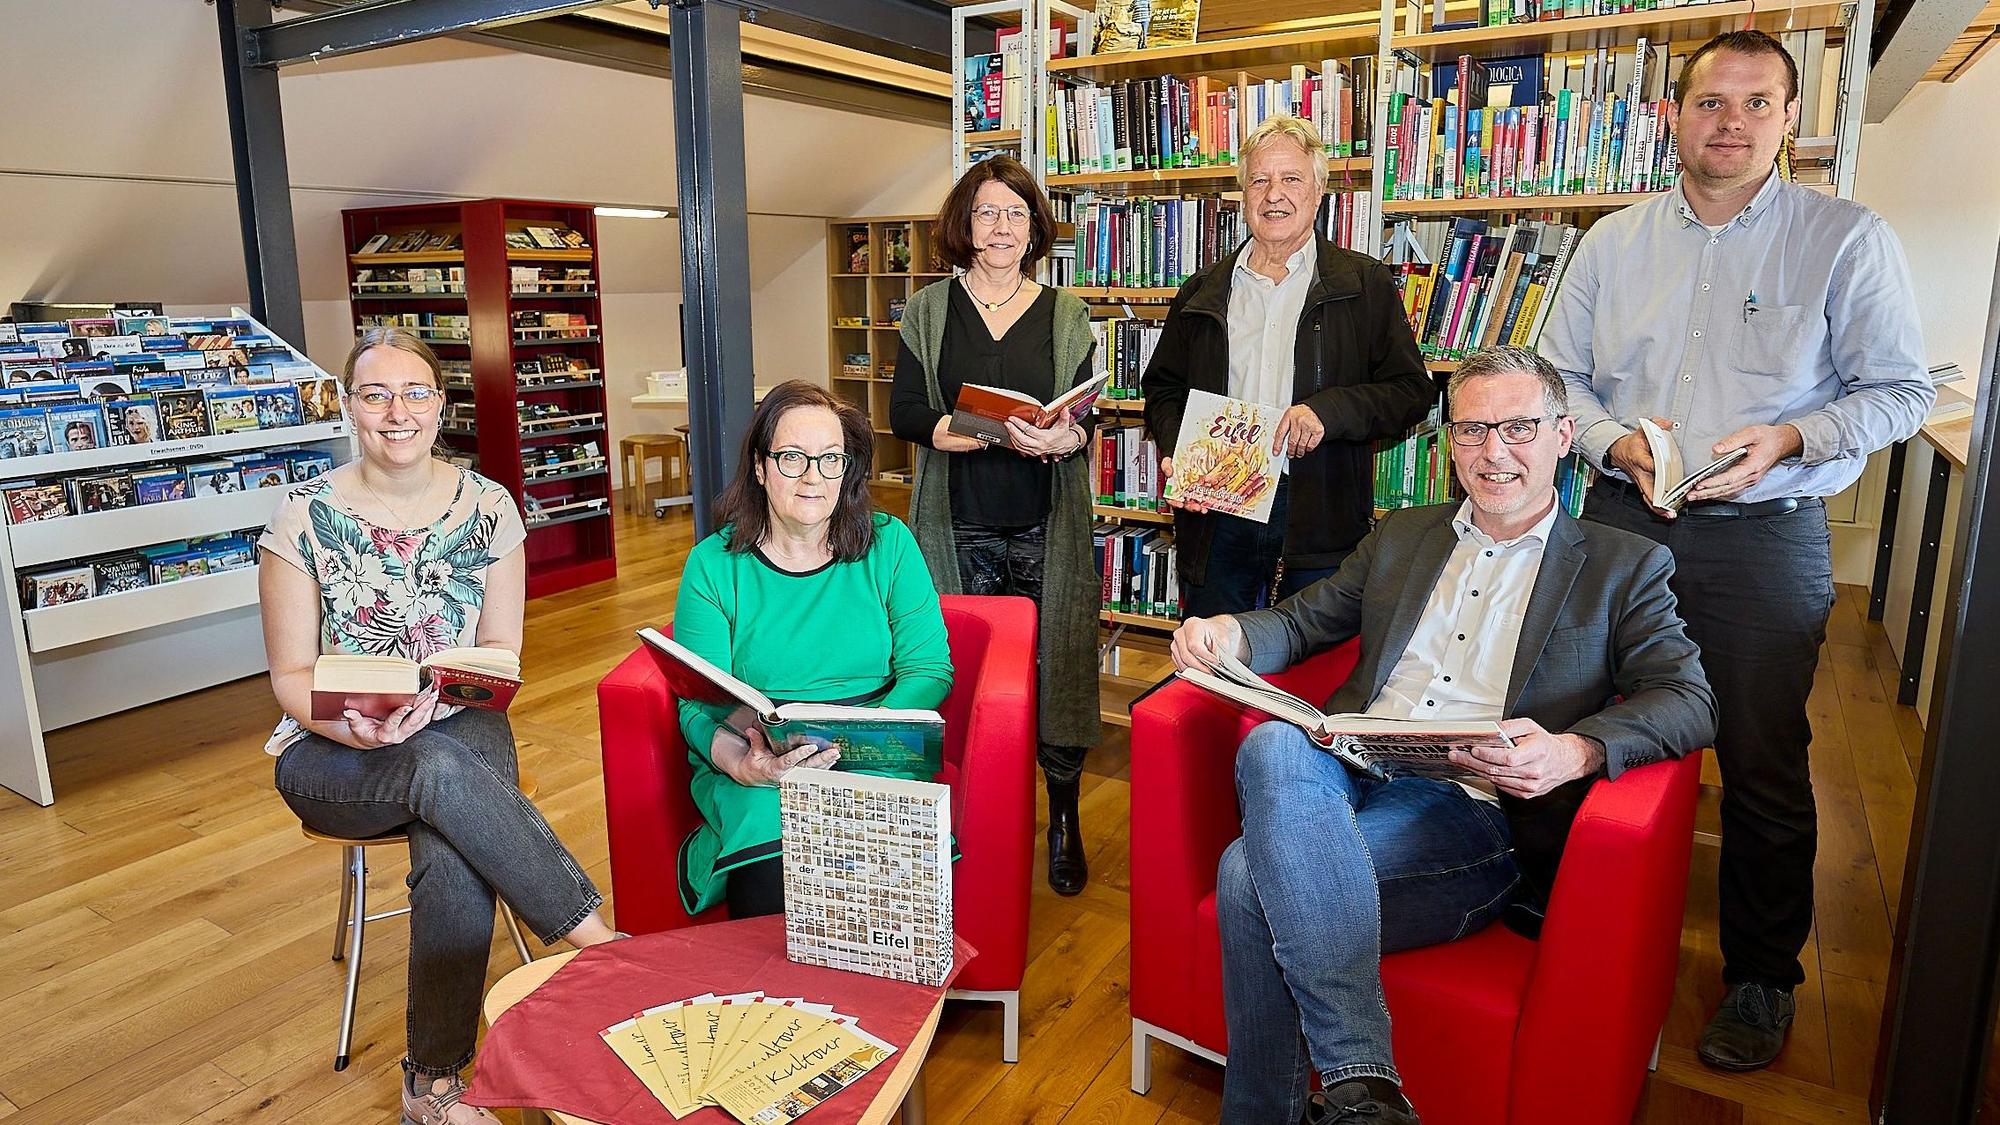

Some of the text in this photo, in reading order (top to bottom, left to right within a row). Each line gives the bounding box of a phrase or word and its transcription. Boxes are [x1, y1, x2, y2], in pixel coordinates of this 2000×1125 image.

[1390, 127, 1398, 144] 2017
[1421, 119, 1429, 139] Wien
[1388, 150, 1396, 169] Europa
[1635, 140, 1644, 163] Ibiza
[1665, 131, 1677, 172] fuerteven
[1438, 228, 1455, 274] SKANDINAVIEN
[1469, 241, 1479, 263] ISLAND
[1550, 233, 1570, 280] DEUTSCHLAND
[132, 365, 149, 373] Frida
[167, 426, 205, 436] ARTHUR
[173, 421, 197, 429] KING
[1209, 415, 1261, 444] Eifel
[112, 434, 130, 446] JOY
[899, 816, 909, 826] in
[798, 865, 815, 875] der
[872, 930, 909, 949] Eifel
[765, 1036, 840, 1086] Kultour
